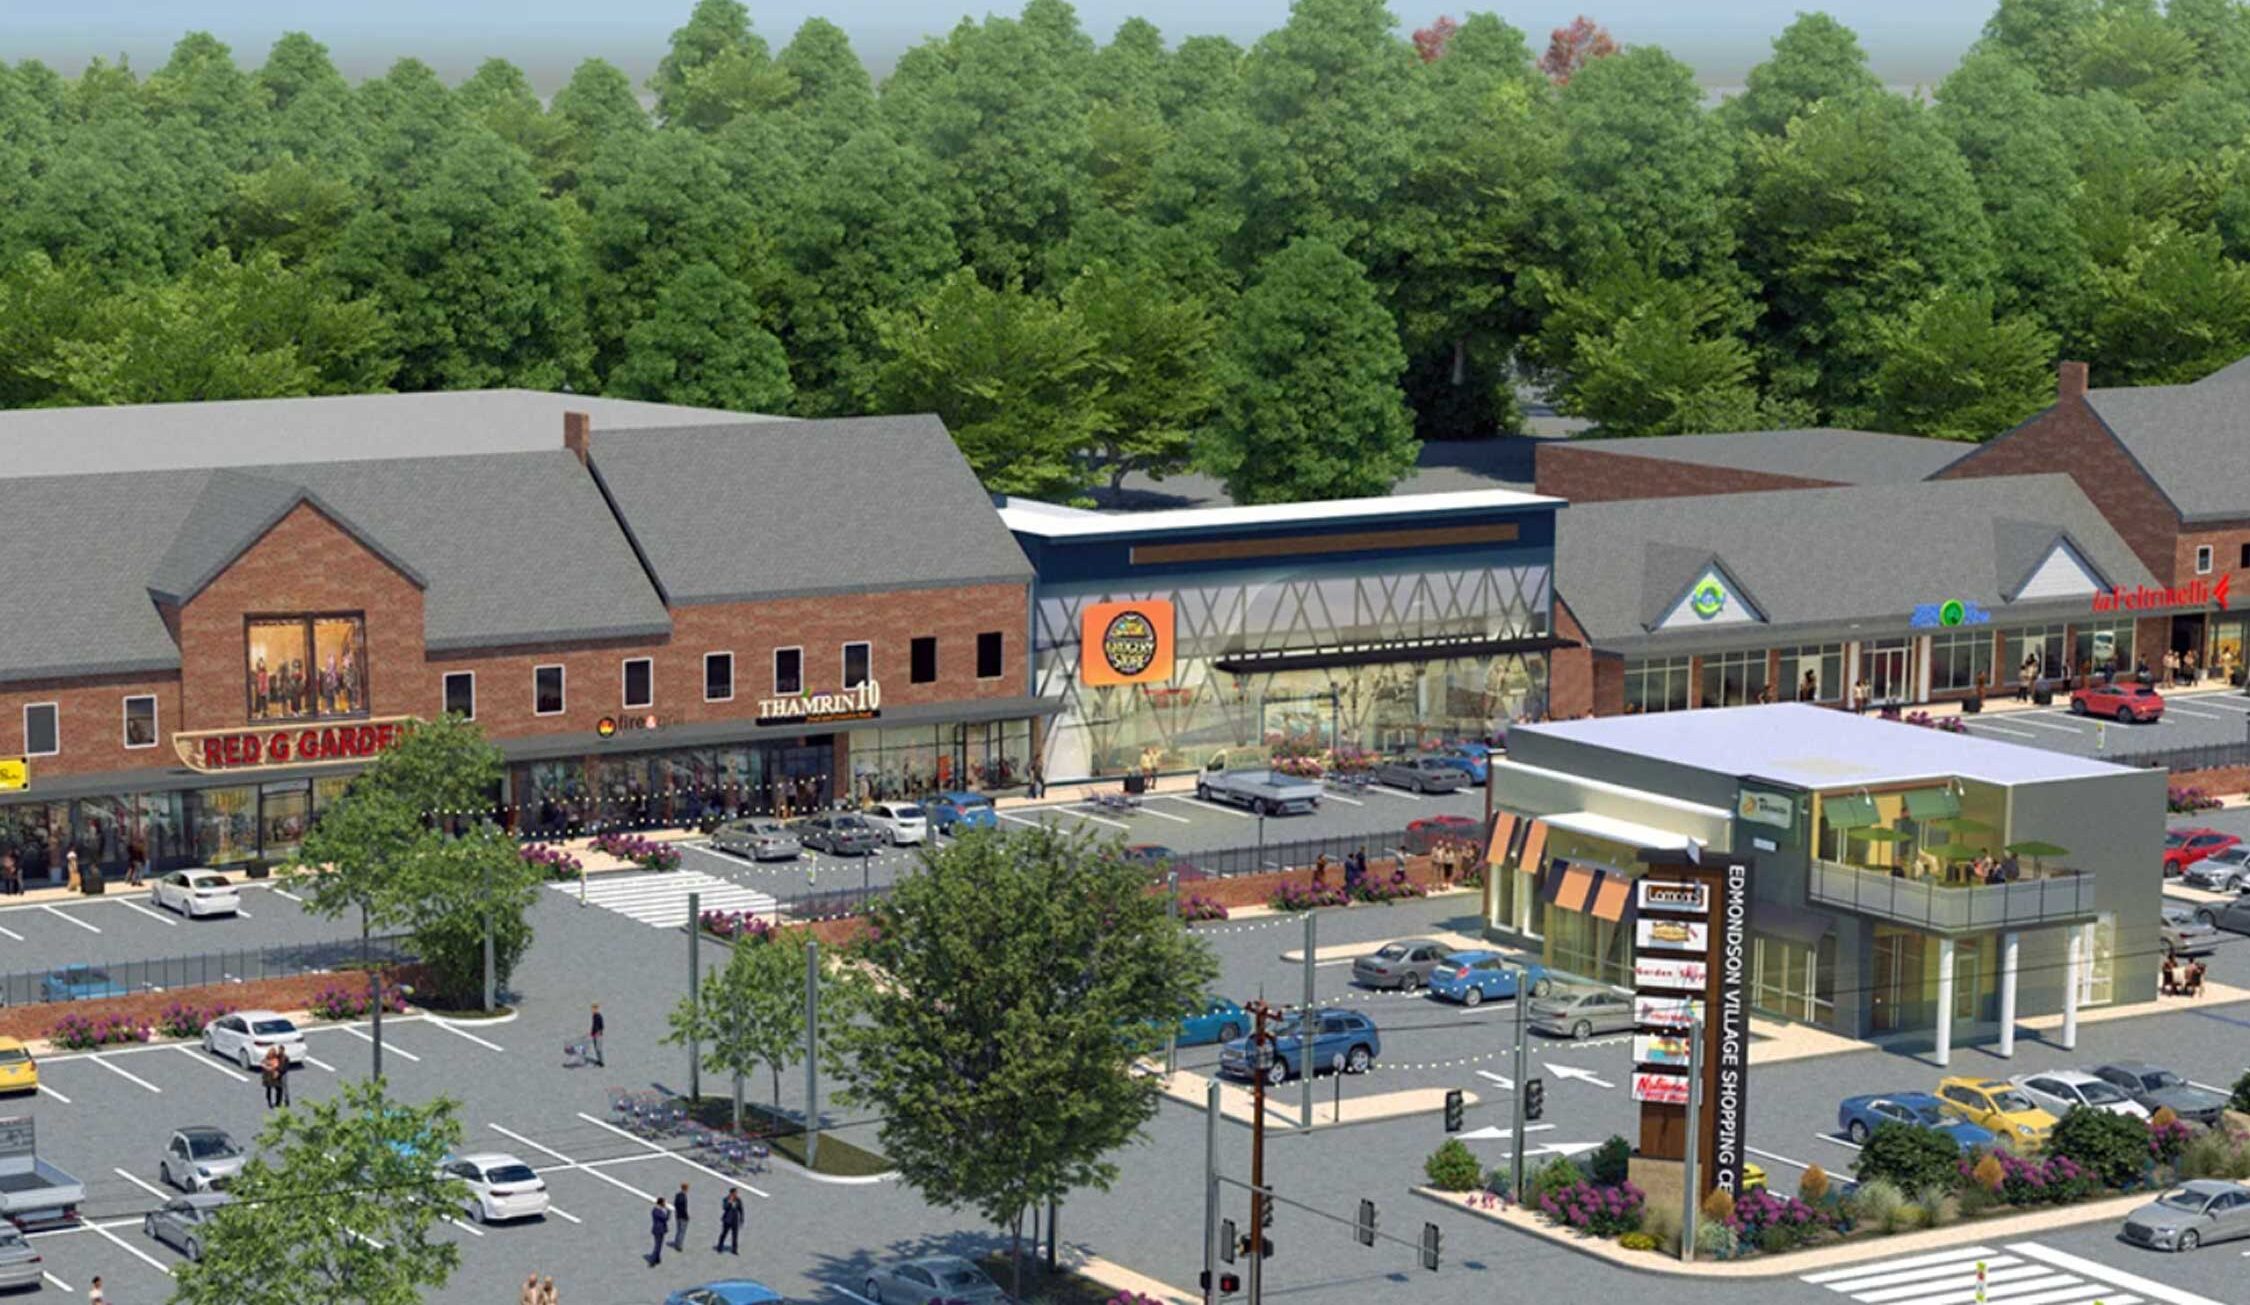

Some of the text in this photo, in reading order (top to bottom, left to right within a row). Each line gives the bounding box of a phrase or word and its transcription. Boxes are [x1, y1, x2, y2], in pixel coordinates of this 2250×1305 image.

[758, 694, 855, 718] THAMRIN
[203, 723, 412, 766] RED G GARDE
[1725, 865, 1745, 984] EDMONDSON
[1723, 990, 1740, 1066] VILLAGE
[1720, 1071, 1738, 1164] SHOPPING
